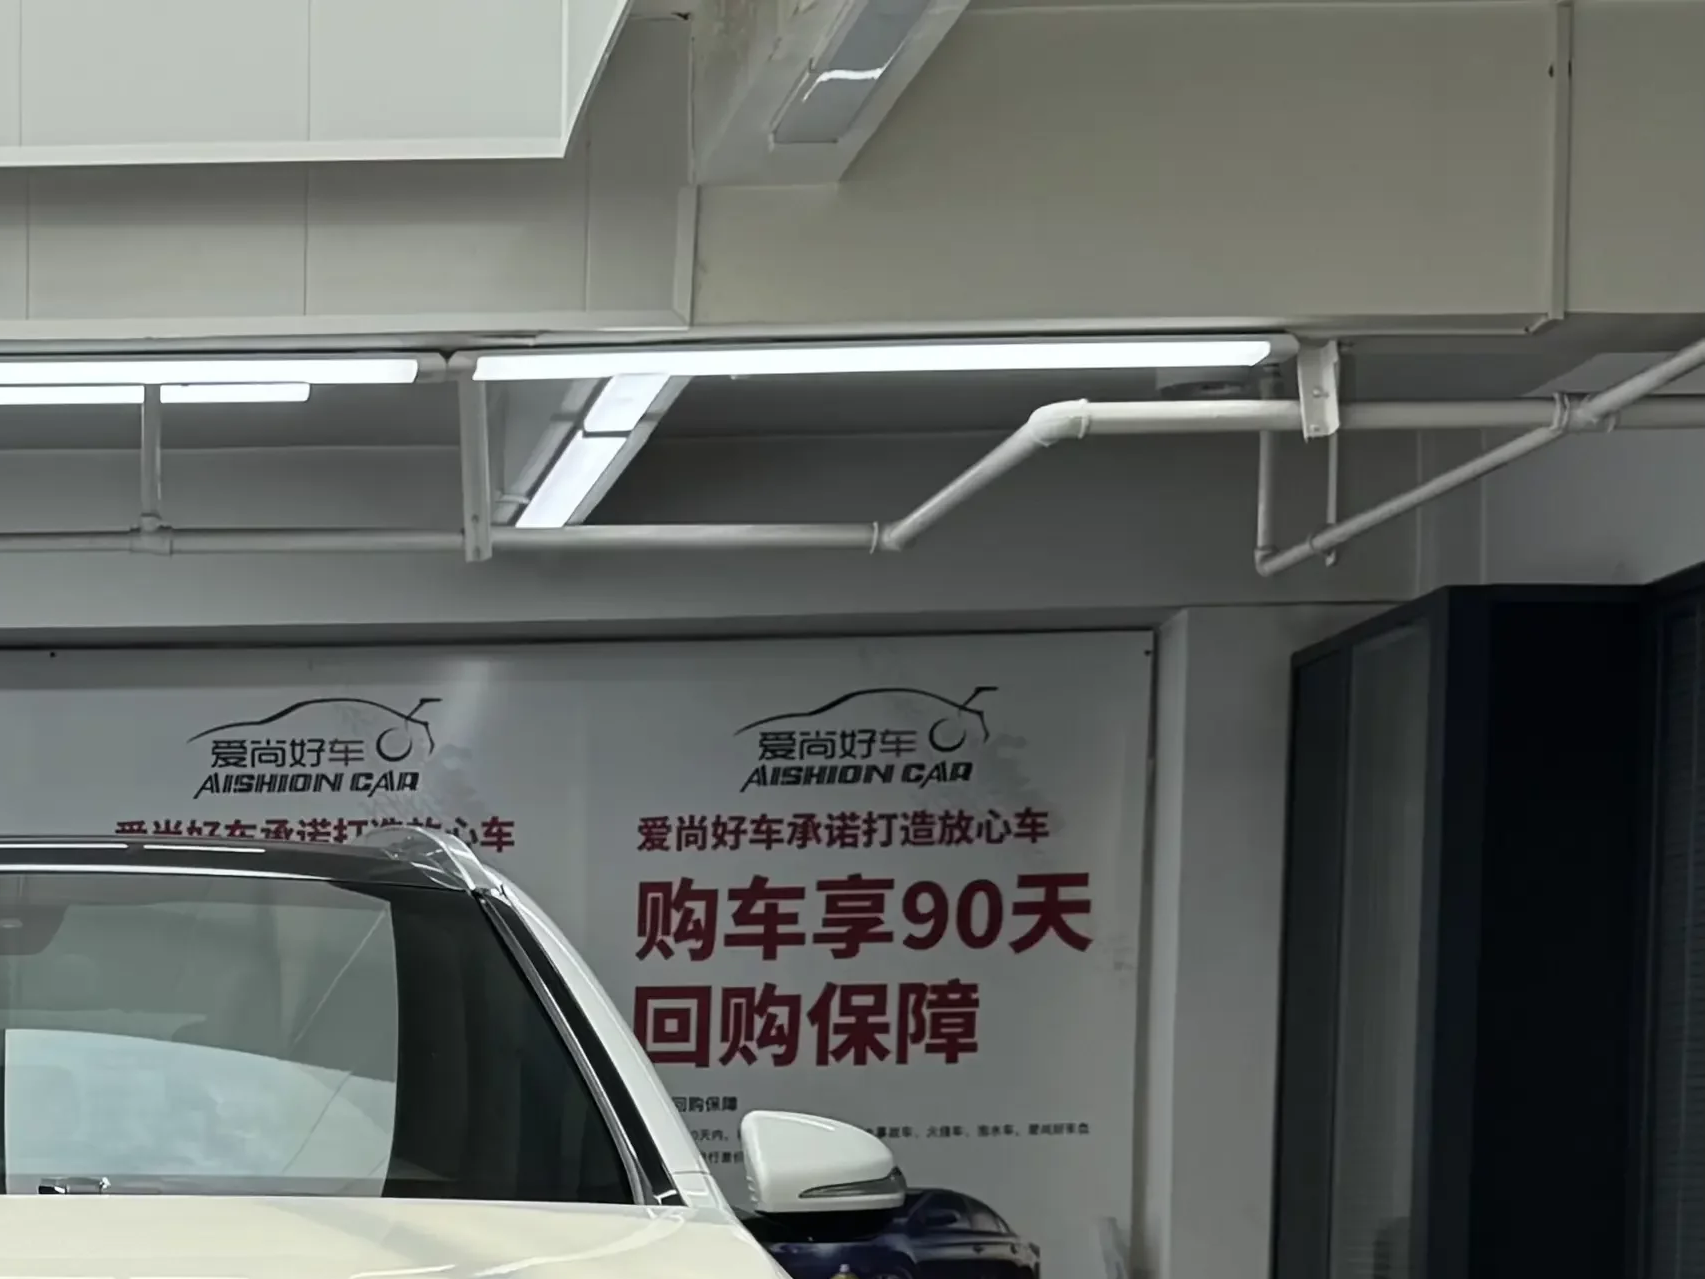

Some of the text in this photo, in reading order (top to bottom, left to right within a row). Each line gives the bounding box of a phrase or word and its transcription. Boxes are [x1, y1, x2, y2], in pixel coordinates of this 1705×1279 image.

[211, 738, 364, 769] 爱尚好车
[758, 728, 918, 761] 爱尚好车
[193, 769, 420, 800] AISHION CAR
[739, 760, 974, 793] AISHION CAR
[637, 806, 1051, 852] 爱尚好车承诺打造放心车
[635, 871, 1094, 962] 购车享90天
[634, 977, 980, 1069] 回购保障
